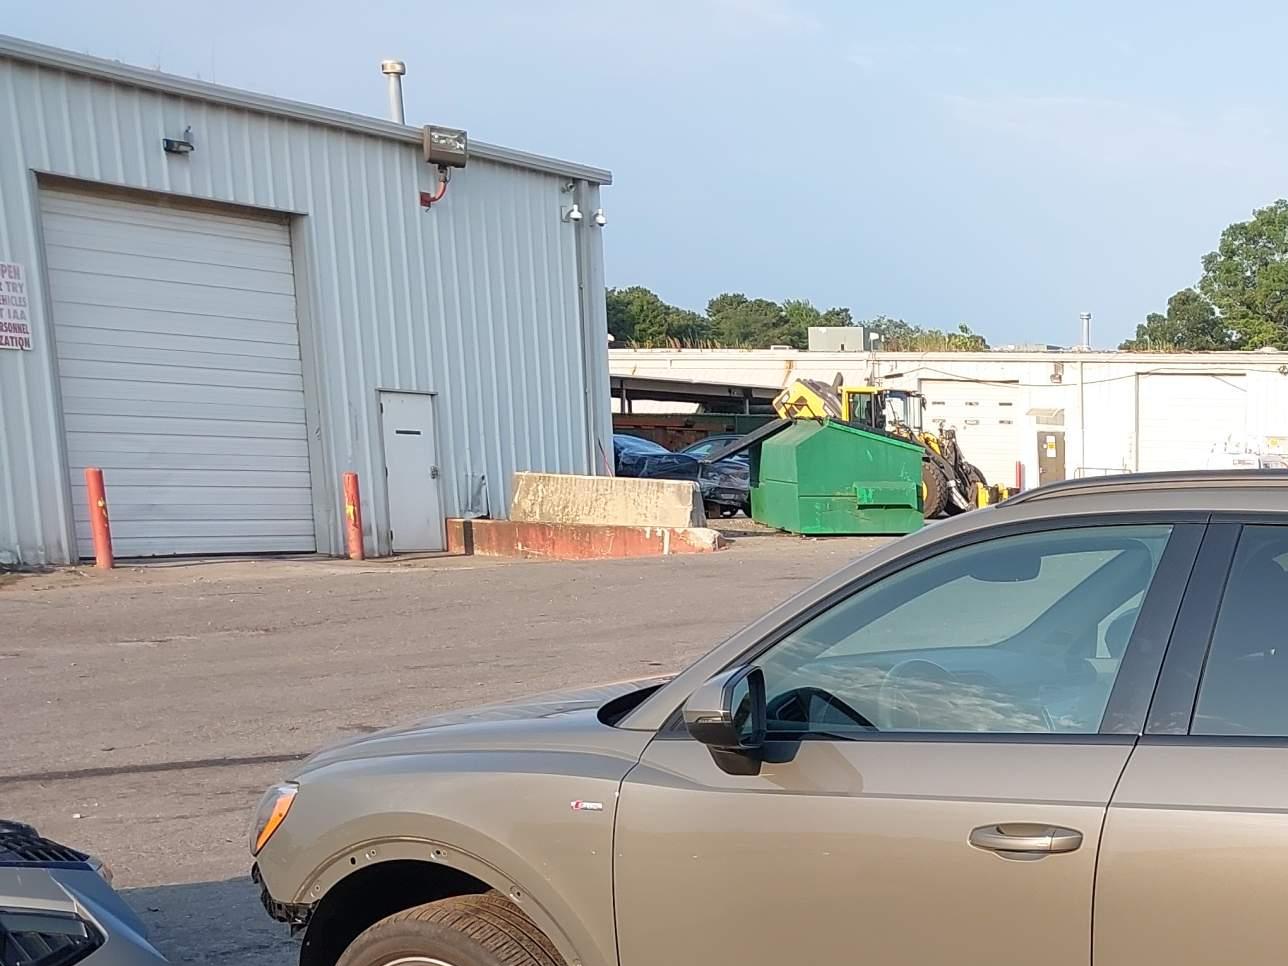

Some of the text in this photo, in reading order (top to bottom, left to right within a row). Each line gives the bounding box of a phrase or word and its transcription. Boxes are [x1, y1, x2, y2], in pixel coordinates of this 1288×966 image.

[0, 264, 20, 279] PEN
[5, 281, 24, 293] TRY
[8, 308, 26, 320] IAA
